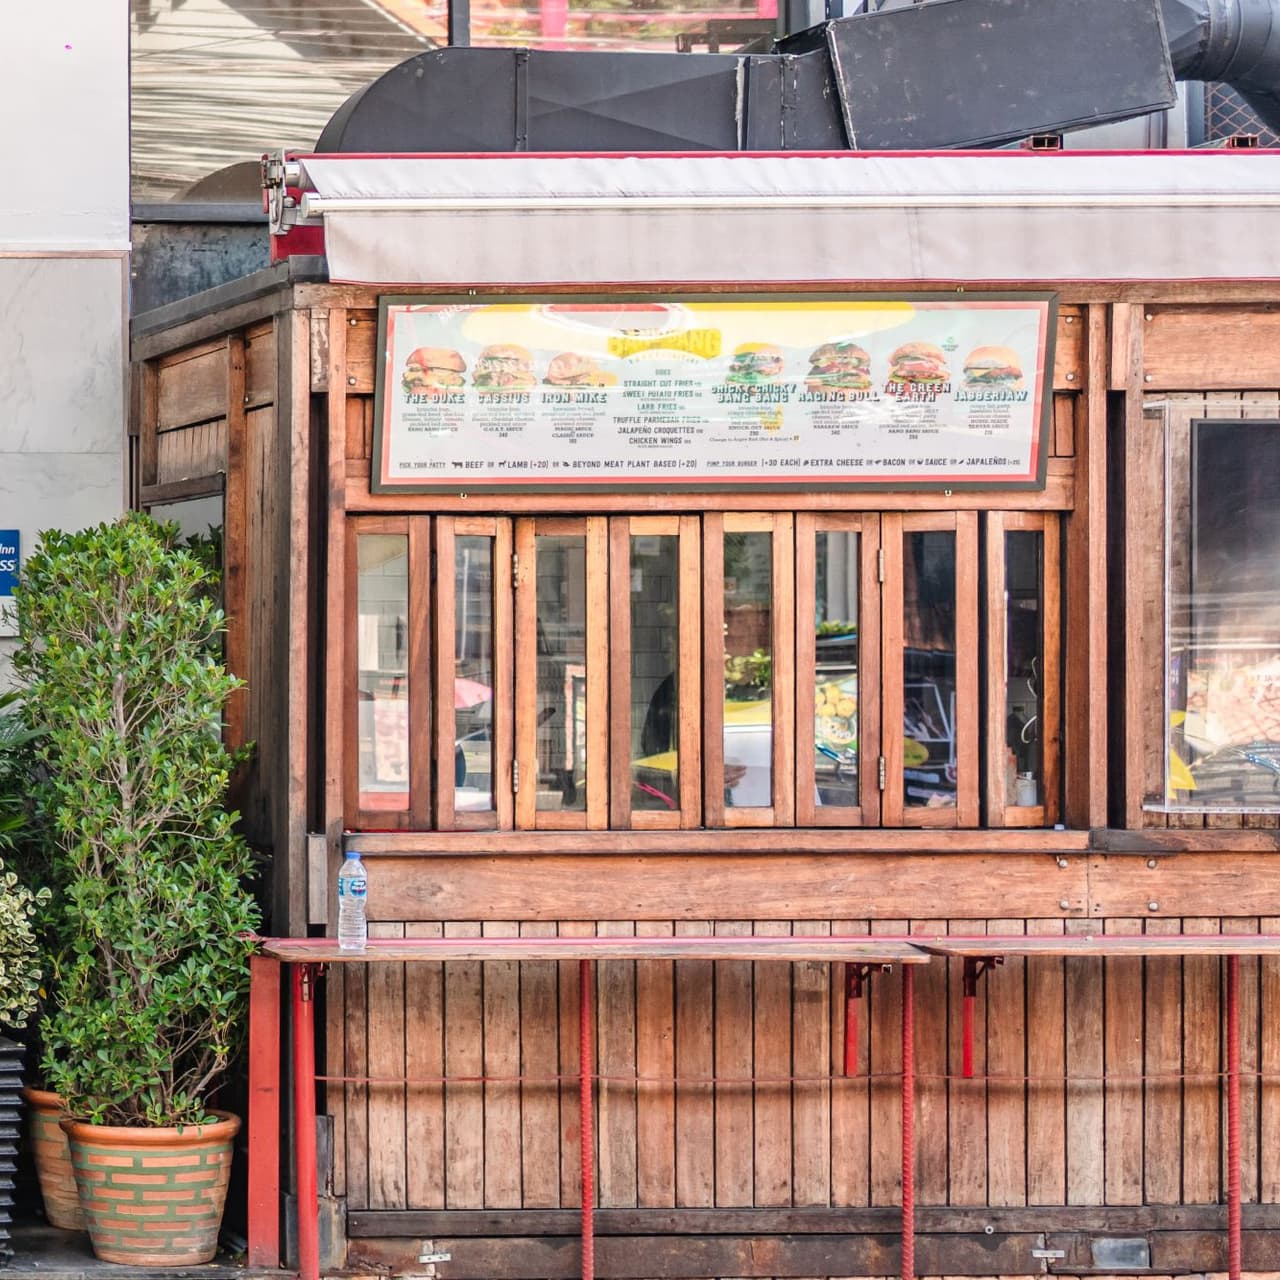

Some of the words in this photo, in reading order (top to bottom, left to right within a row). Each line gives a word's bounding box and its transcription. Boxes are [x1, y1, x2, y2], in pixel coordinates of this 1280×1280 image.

[541, 392, 570, 403] IRON
[576, 392, 607, 403] MIKE
[654, 460, 676, 468] BASED
[811, 459, 833, 467] EXTRA
[883, 458, 906, 466] BACON
